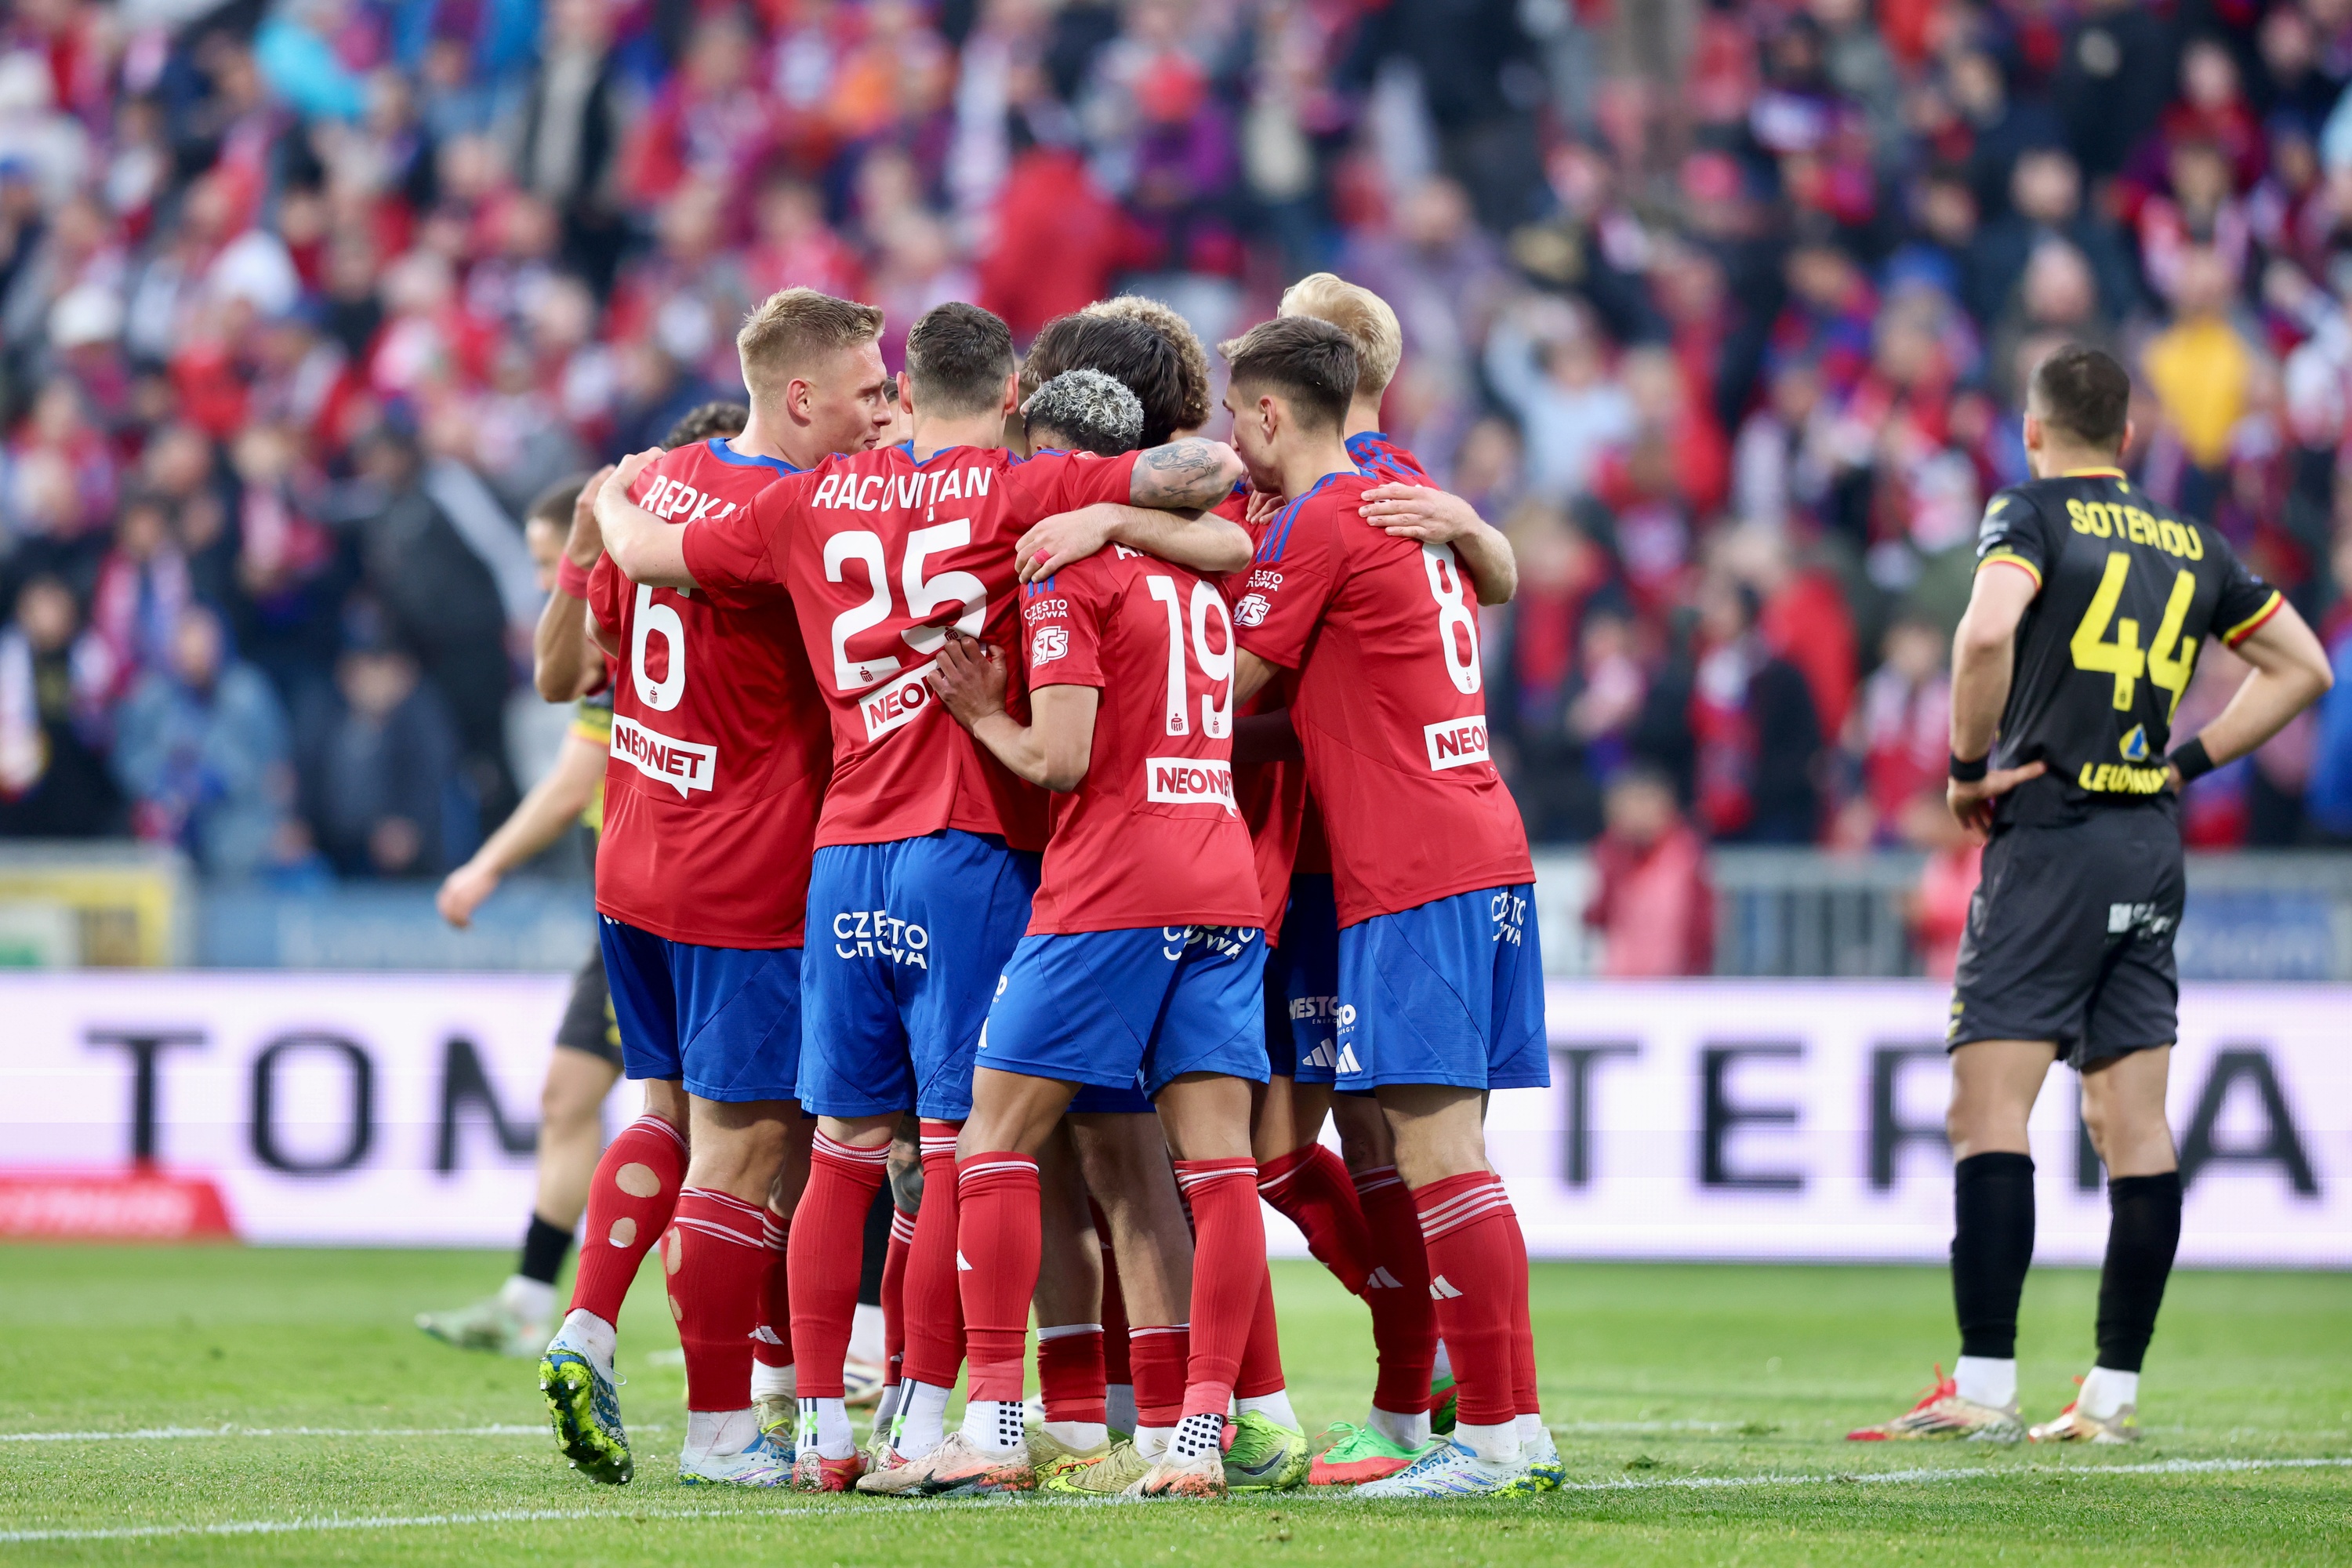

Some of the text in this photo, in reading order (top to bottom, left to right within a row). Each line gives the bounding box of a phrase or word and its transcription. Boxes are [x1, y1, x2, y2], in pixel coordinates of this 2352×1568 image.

[632, 584, 689, 712] 6
[823, 518, 988, 691] 25
[1032, 626, 1069, 669] STS
[1145, 575, 1236, 739] 19
[1421, 543, 1481, 695] 8
[2070, 552, 2198, 728] 44
[615, 724, 706, 779] NEONET
[1156, 767, 1232, 799] NEONE
